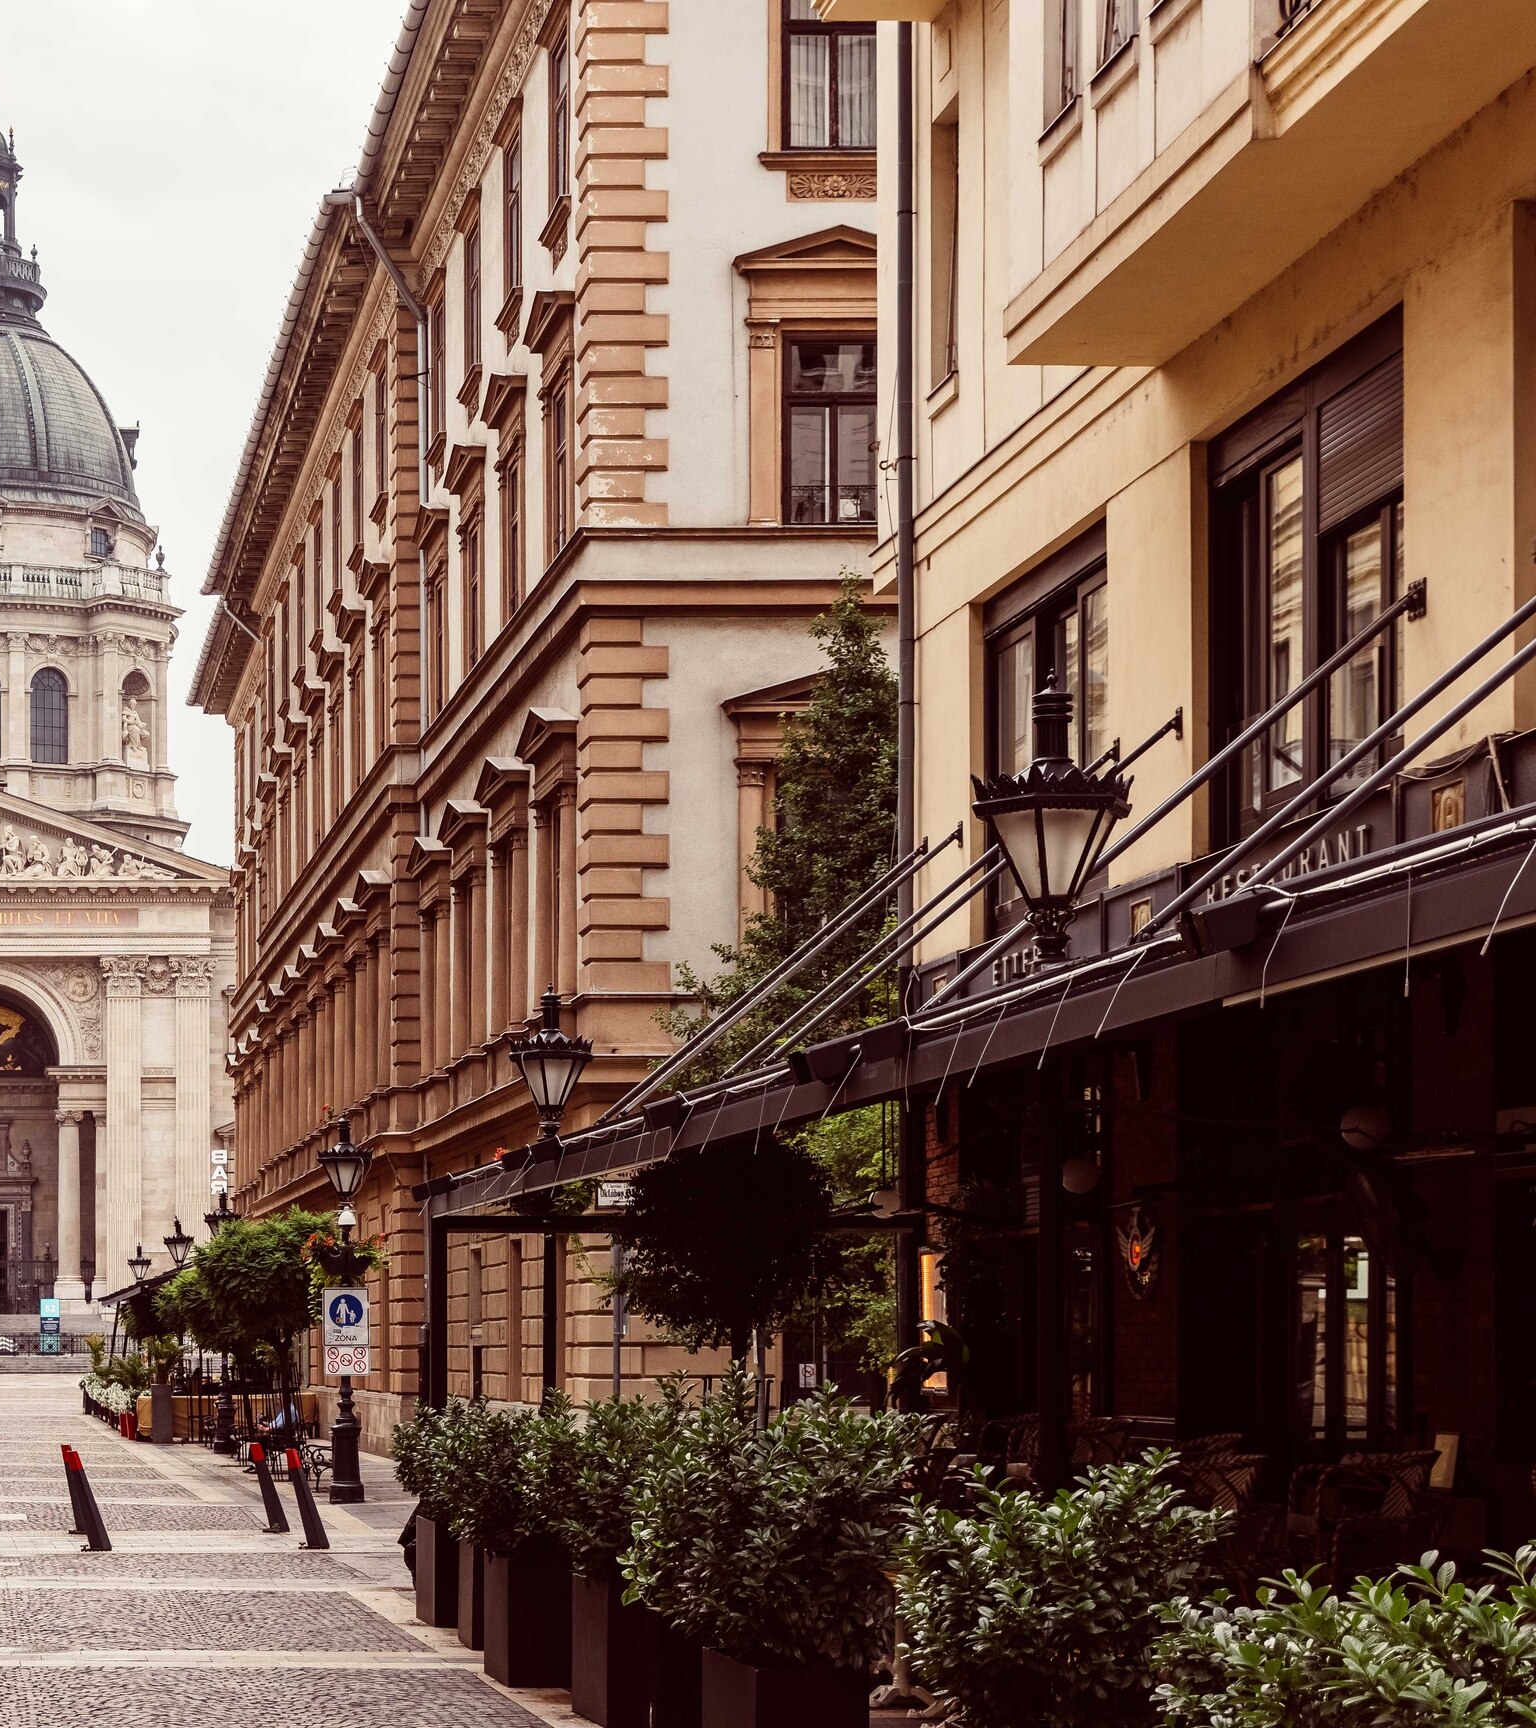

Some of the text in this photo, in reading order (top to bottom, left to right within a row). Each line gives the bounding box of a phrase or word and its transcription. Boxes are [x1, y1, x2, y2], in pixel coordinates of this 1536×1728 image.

[55, 912, 74, 925] ET
[85, 912, 120, 925] VITA
[45, 1304, 56, 1313] 52
[334, 1333, 358, 1342] ZÓNA
